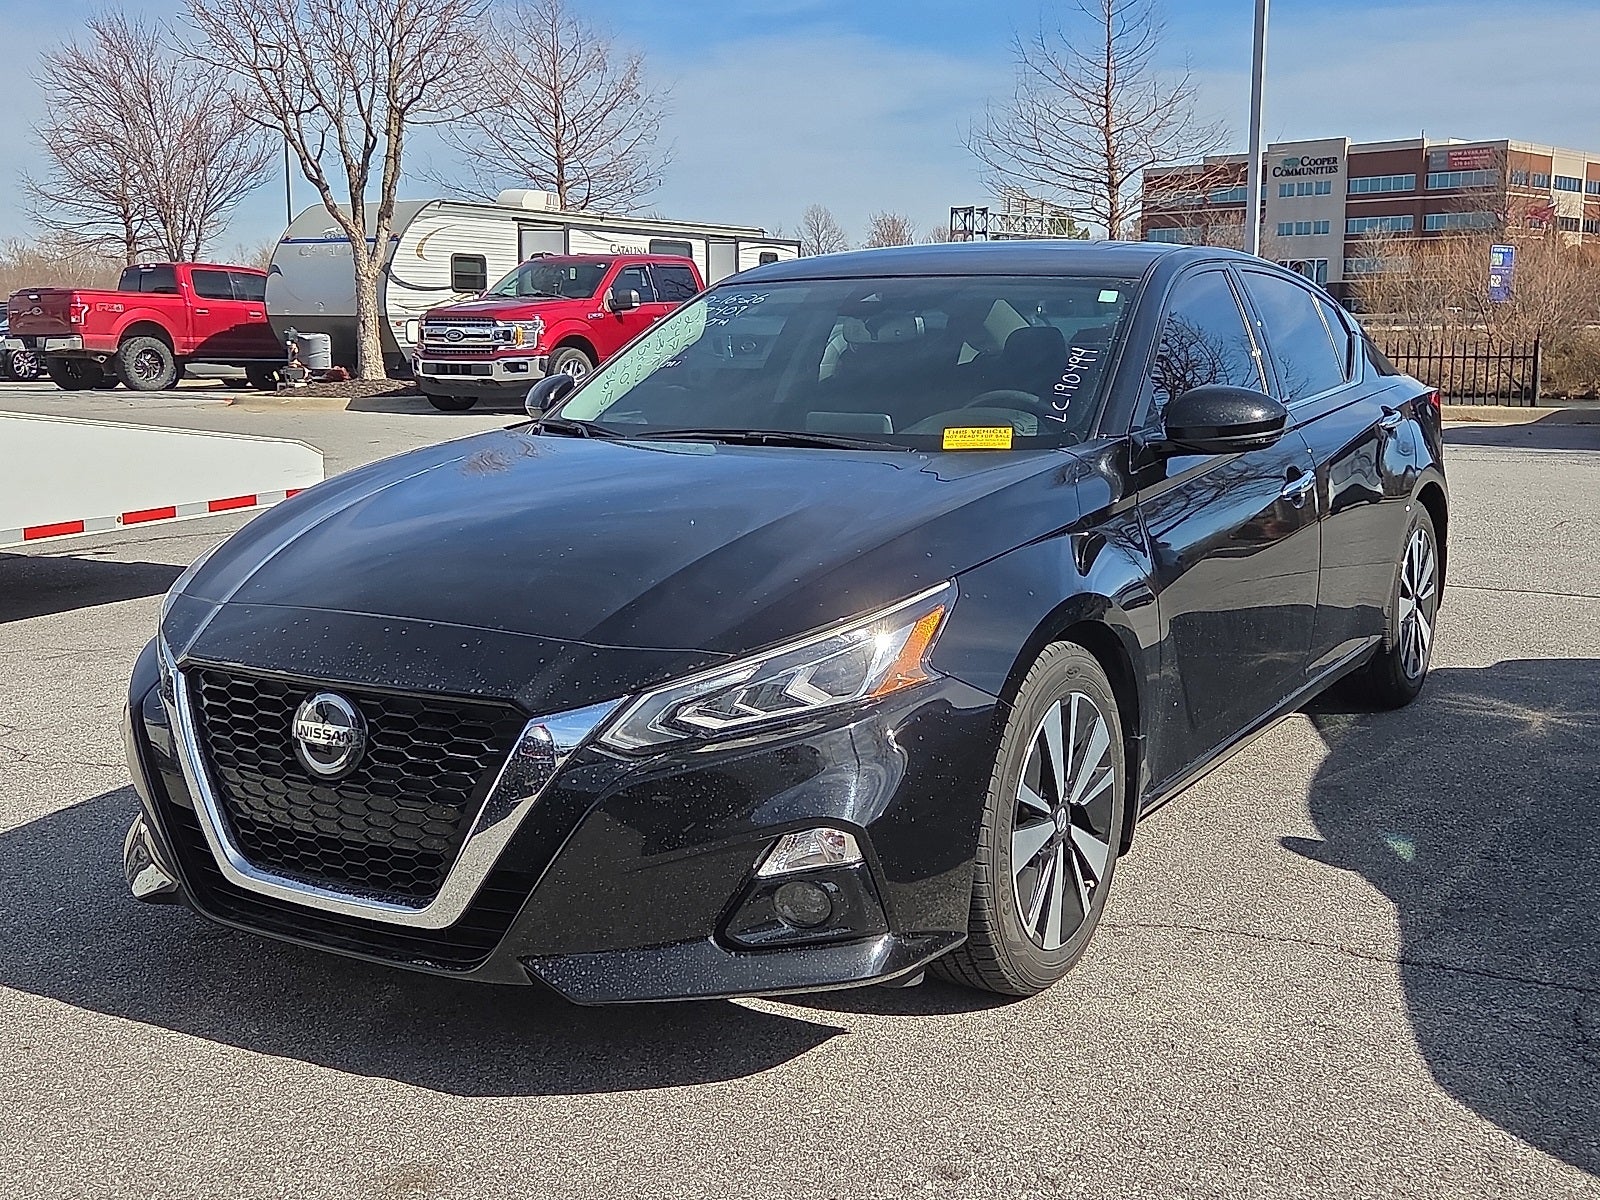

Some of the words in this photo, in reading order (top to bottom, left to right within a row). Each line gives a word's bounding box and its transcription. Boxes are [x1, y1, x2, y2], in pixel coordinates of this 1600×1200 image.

[1301, 156, 1338, 166] COOPER
[1272, 166, 1338, 177] COMMUNITIES
[610, 244, 647, 255] CATALINA
[1045, 346, 1099, 423] LC190494
[298, 724, 353, 743] NISSAN
